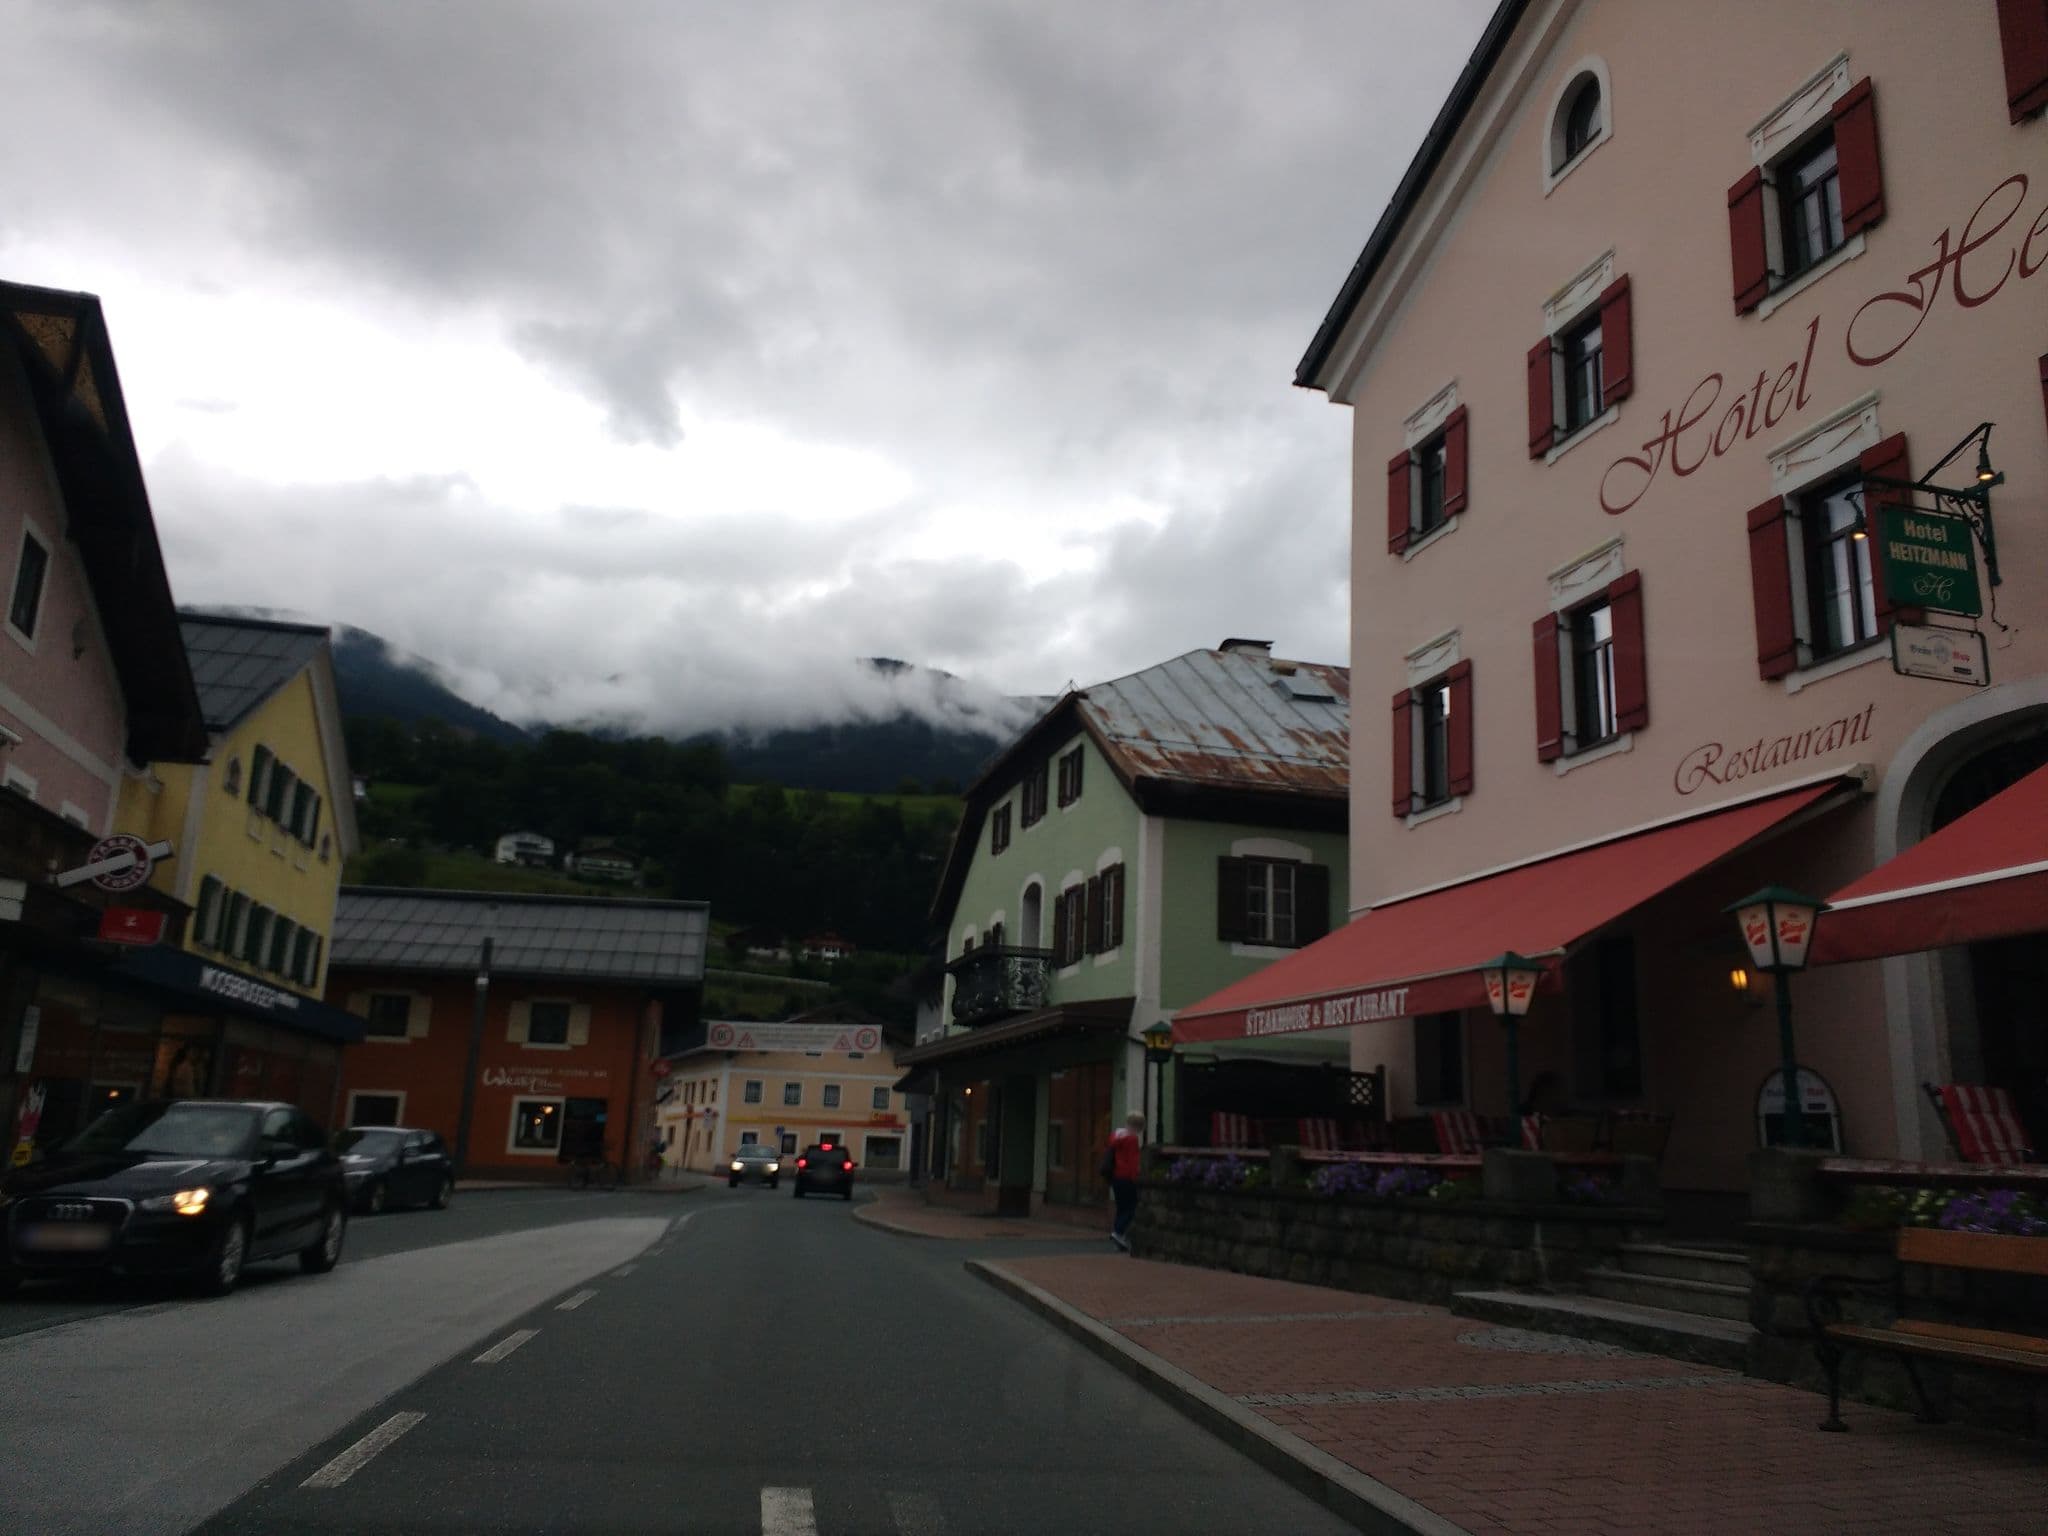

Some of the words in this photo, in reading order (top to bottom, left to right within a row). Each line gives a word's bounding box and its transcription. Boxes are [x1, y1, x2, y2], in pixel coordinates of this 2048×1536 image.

[1600, 315, 1820, 515] Hotel
[1889, 540, 1969, 571] HEITZMANN
[1903, 519, 1948, 543] Hotel
[1675, 703, 1874, 795] Restaurant
[1246, 1004, 1311, 1036] STEAKHOUSE
[1312, 1003, 1321, 1025] &
[1322, 987, 1409, 1026] RESTAURANT
